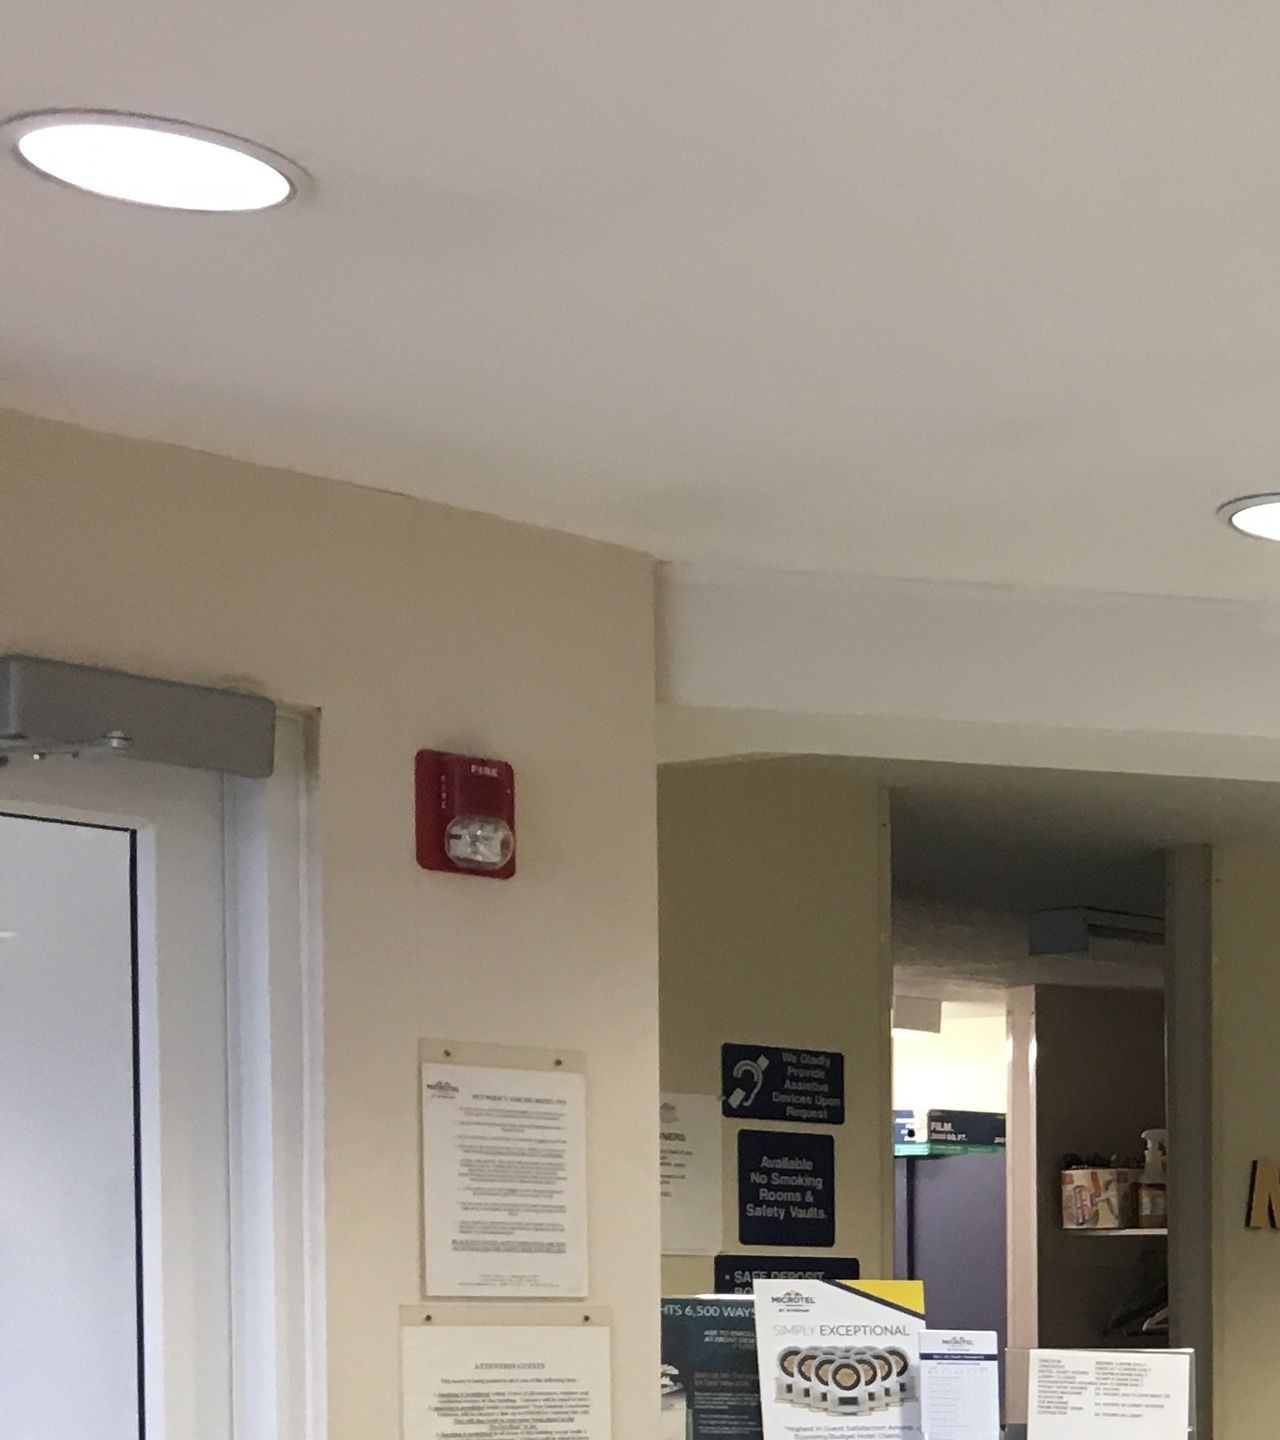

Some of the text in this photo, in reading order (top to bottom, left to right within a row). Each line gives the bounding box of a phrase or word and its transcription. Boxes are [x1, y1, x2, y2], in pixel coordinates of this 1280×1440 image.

[471, 764, 498, 777] FIRE
[760, 1156, 814, 1170] Available
[750, 1172, 823, 1190] No Smoking
[759, 1188, 814, 1203] Rooms &
[746, 1204, 786, 1220] Safety
[771, 1296, 816, 1304] MICROTEL
[685, 1305, 720, 1318] 6,500
[772, 1324, 911, 1337] SIMPLY EXCEPTIONAL
